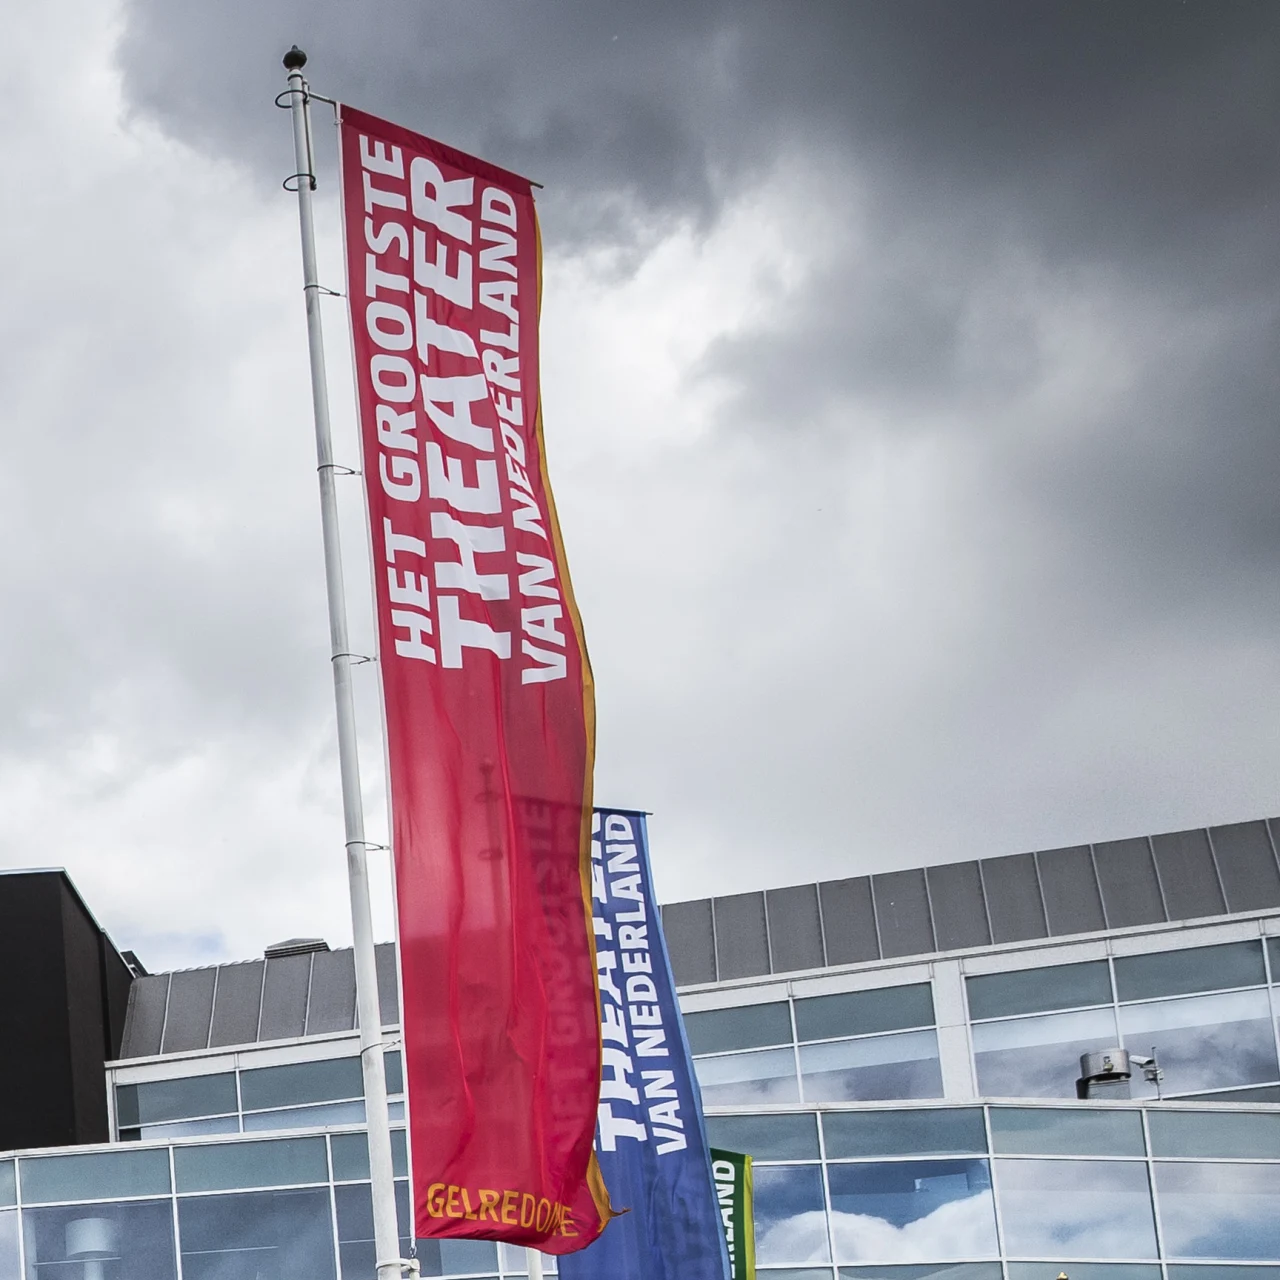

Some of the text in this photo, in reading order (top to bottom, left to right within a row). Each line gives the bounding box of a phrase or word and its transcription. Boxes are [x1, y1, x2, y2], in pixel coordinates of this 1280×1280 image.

[359, 134, 437, 665] HET GROOTSTE
[409, 155, 512, 669] THEATER
[478, 185, 567, 686] VAN NEDERLAND
[426, 1182, 579, 1237] GELREDOME
[605, 814, 688, 1155] VAN NEDERLAND
